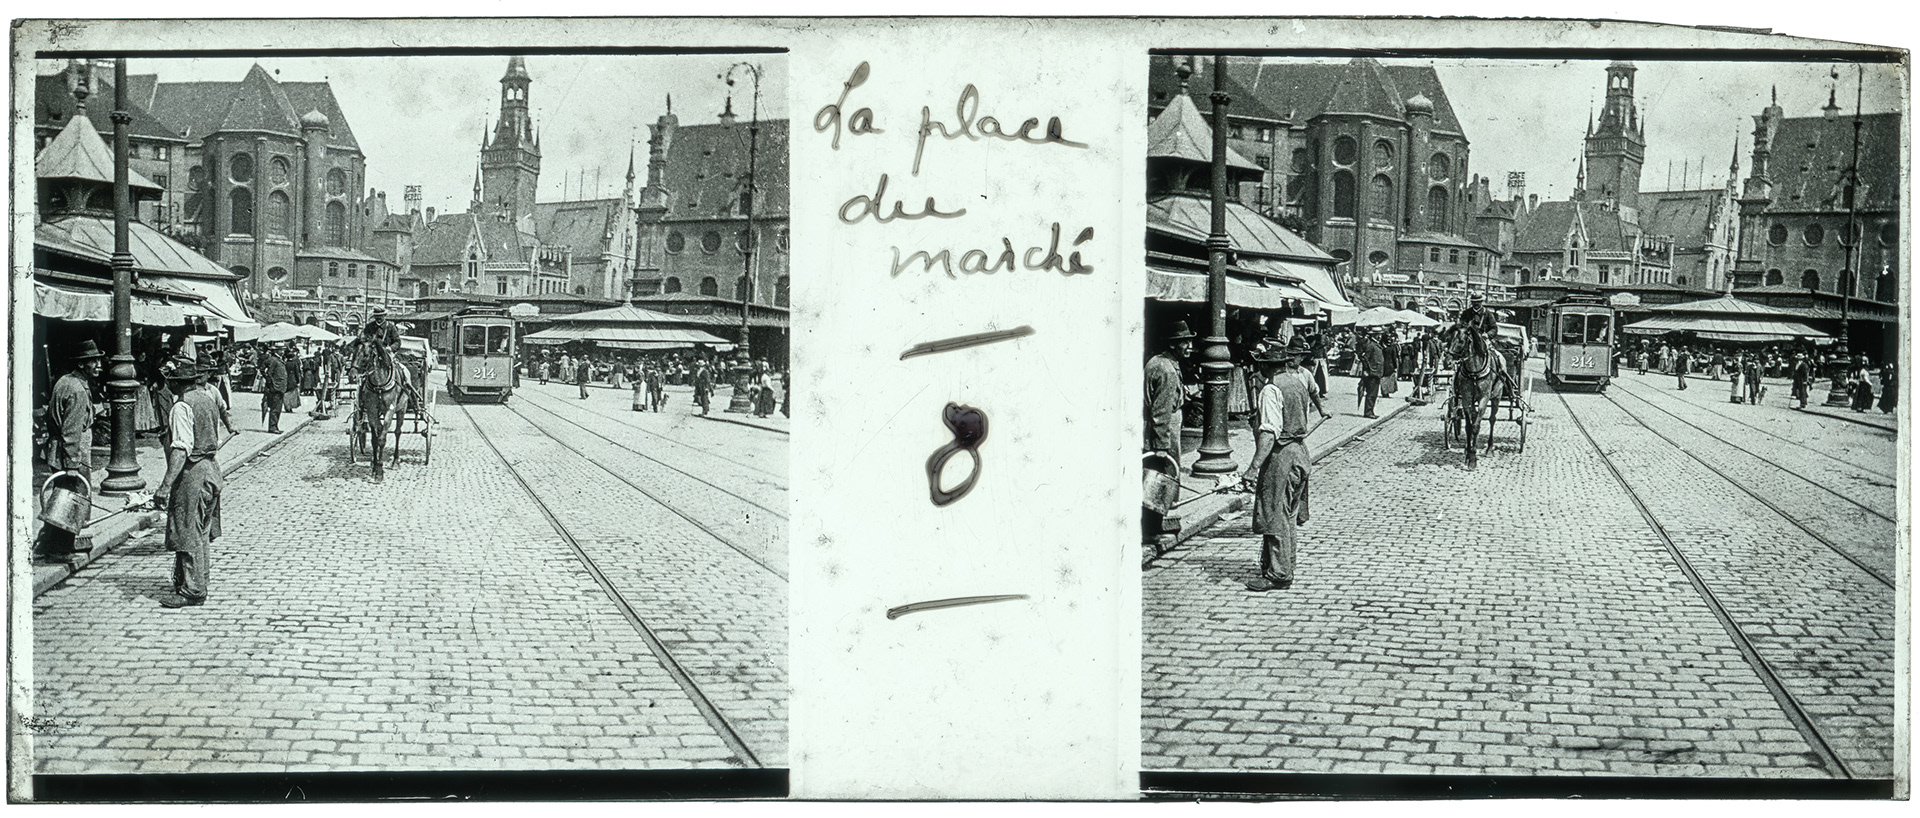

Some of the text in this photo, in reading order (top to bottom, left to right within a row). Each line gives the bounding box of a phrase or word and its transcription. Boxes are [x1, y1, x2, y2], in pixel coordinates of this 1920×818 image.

[813, 60, 1090, 177] La place
[838, 172, 967, 224] du
[890, 221, 1095, 281] marché
[473, 366, 498, 380] 214
[1571, 355, 1595, 369] 214
[925, 401, 990, 508] 8
